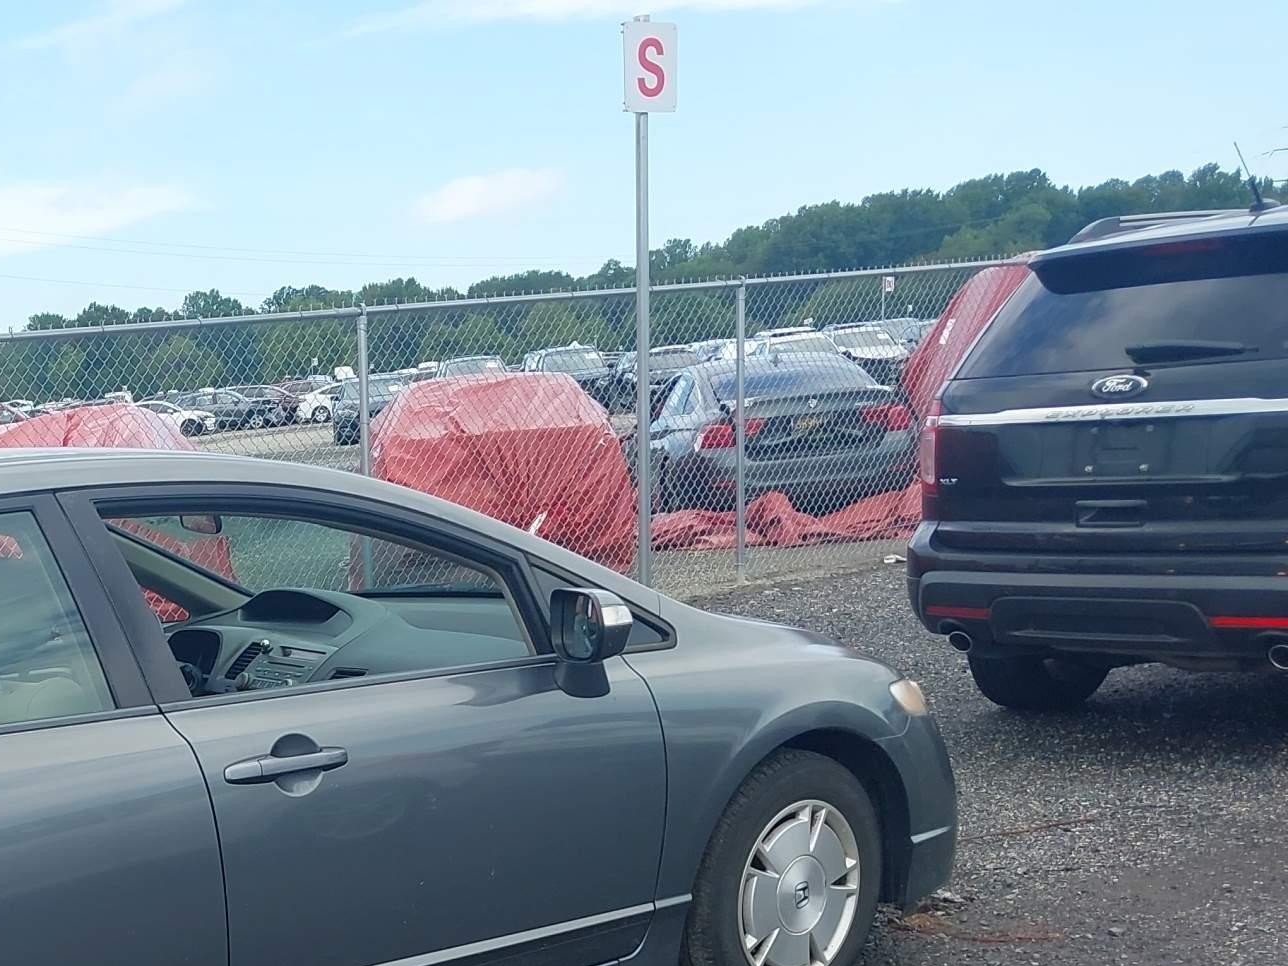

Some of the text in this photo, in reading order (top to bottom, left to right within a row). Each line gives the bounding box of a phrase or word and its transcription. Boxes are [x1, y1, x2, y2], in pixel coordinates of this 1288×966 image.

[637, 37, 665, 97] S
[1102, 378, 1133, 393] Ford
[1045, 405, 1194, 419] EXPLORER
